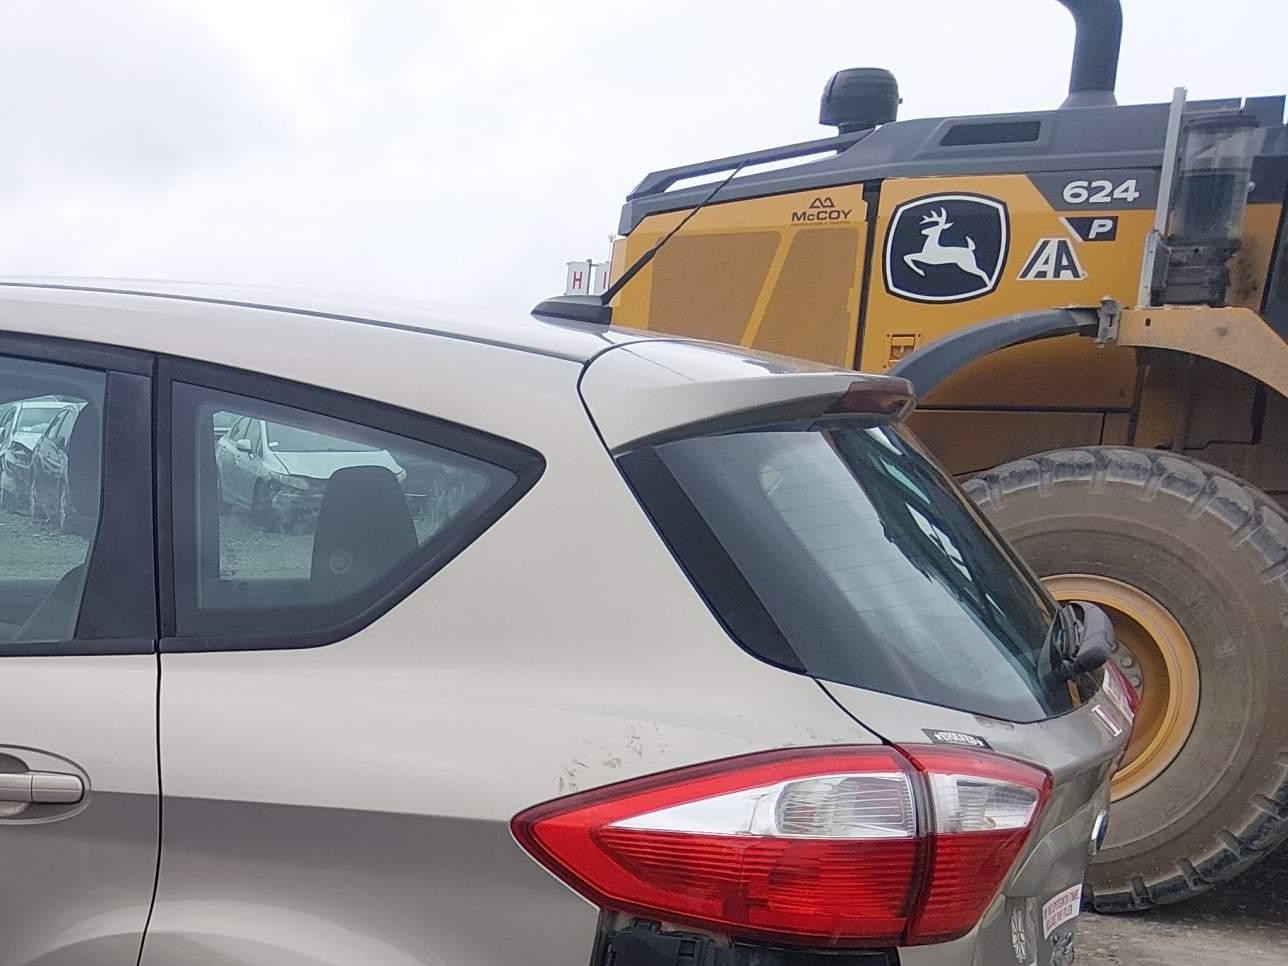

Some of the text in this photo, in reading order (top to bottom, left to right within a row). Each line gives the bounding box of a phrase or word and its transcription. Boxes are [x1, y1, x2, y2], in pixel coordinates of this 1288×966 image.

[1062, 179, 1140, 204] 624
[792, 209, 852, 221] McCOY
[1088, 219, 1113, 239] P
[572, 271, 583, 289] H
